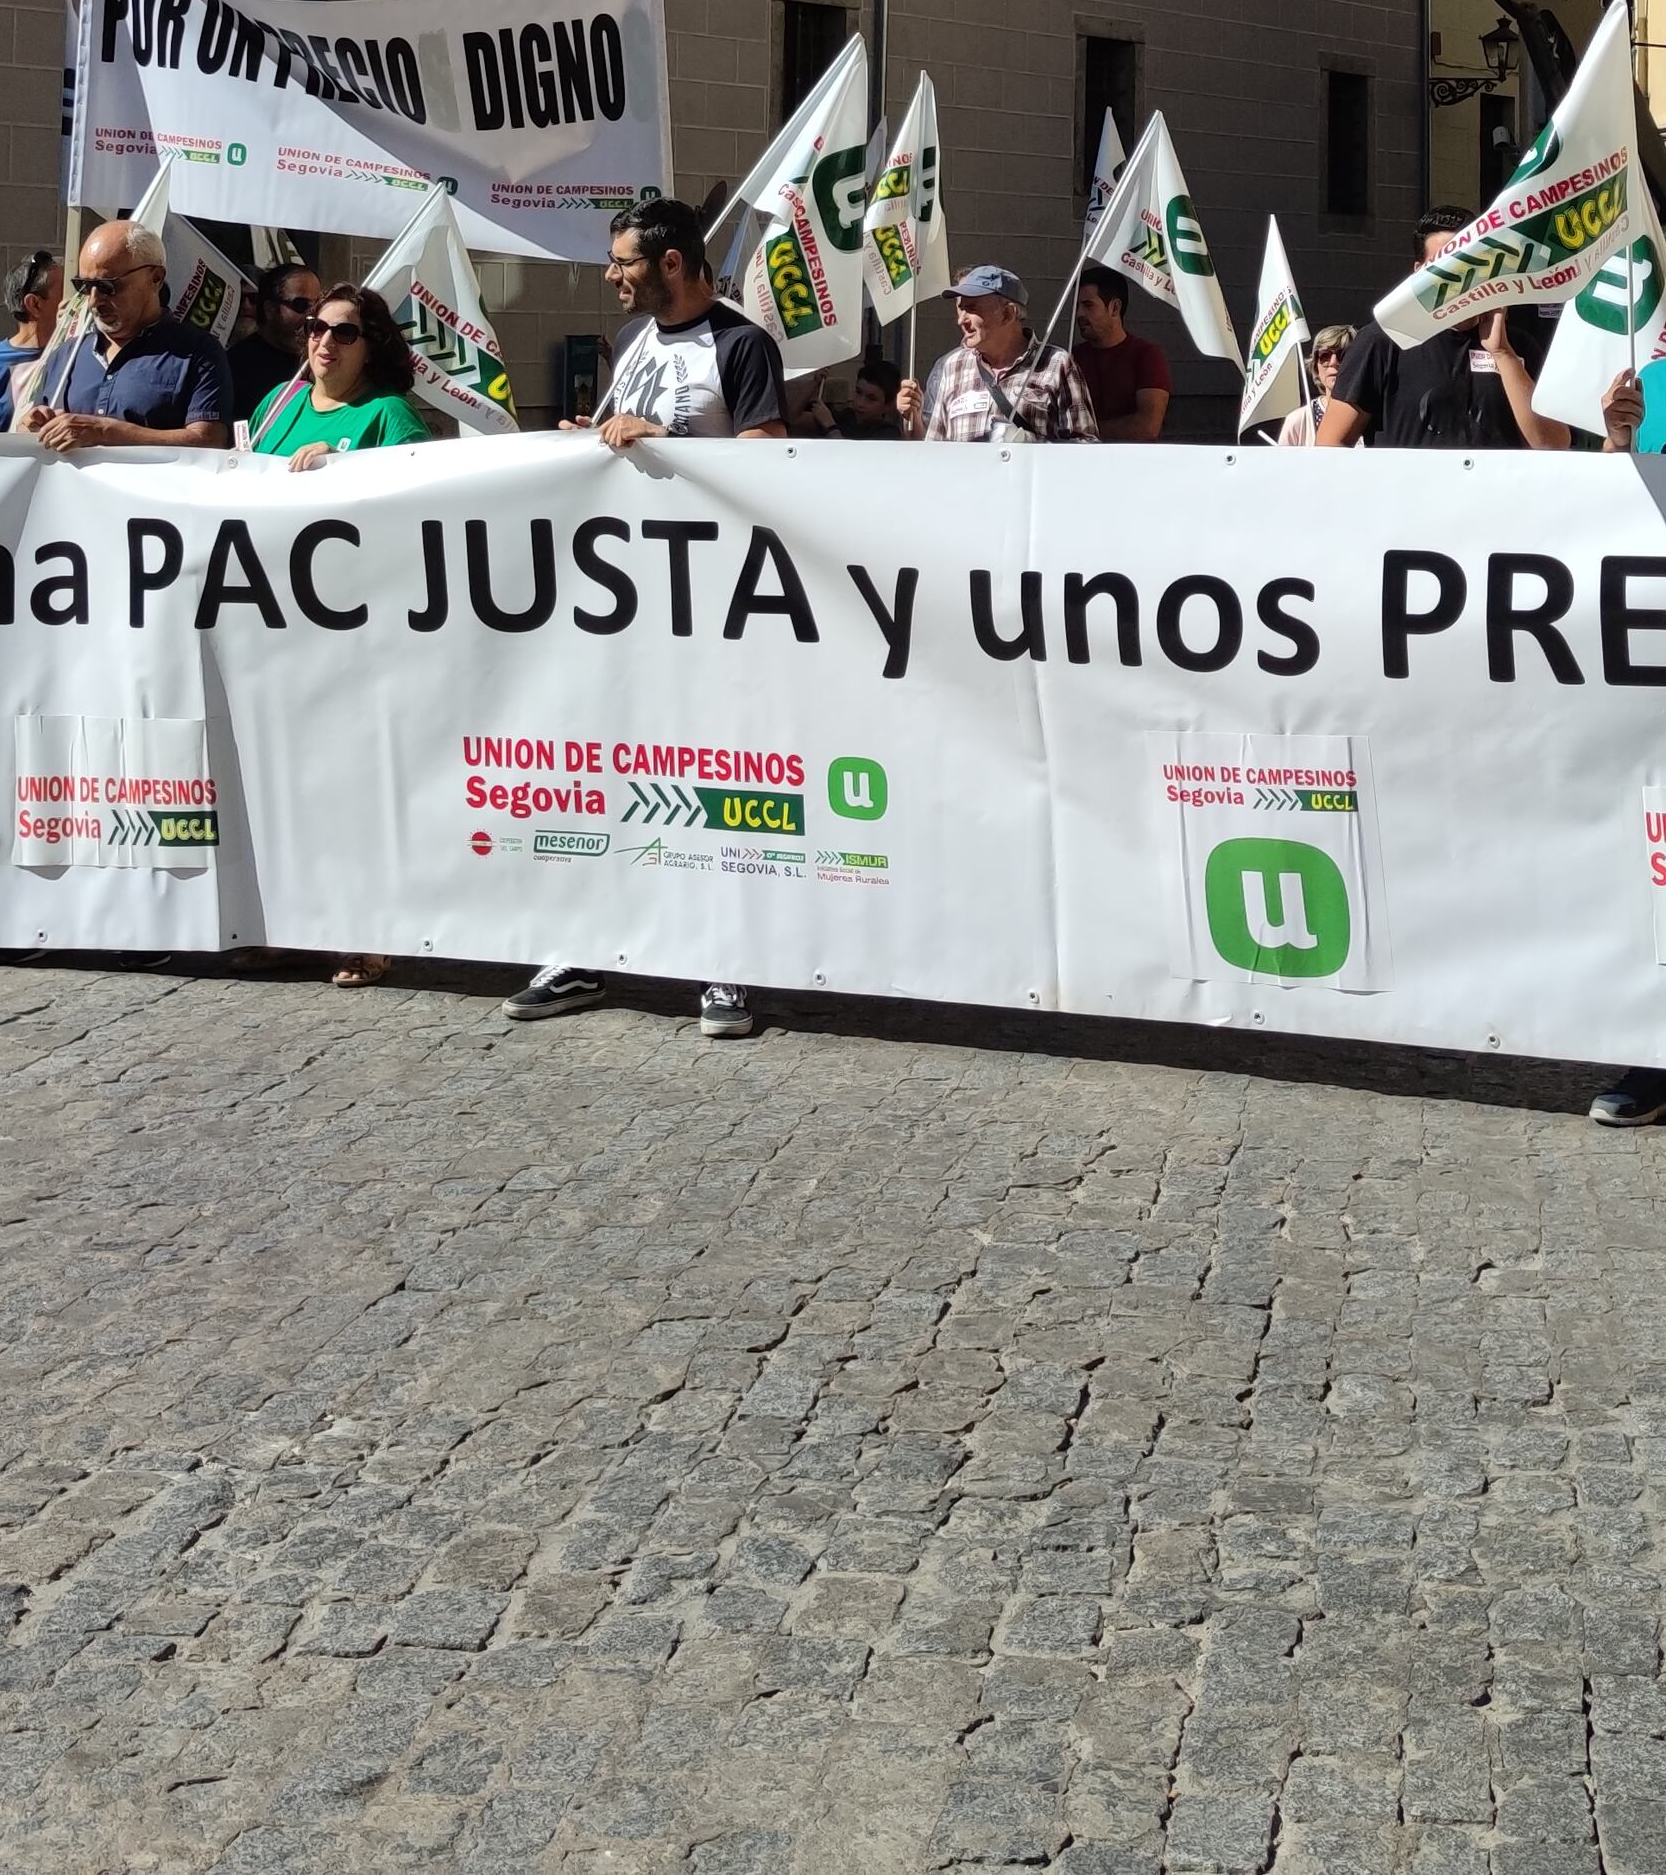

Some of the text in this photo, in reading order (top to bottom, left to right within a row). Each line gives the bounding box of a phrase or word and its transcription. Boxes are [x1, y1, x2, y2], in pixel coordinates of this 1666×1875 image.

[263, 21, 427, 126] PRECIO
[463, 14, 627, 132] DIGNO
[95, 127, 222, 150] UNION DE CAMPESINOS
[95, 139, 158, 156] Segovia
[277, 147, 431, 181] UNION DE CAMPESINOS
[277, 159, 343, 178] Segovia
[490, 194, 556, 209] Segovia
[492, 183, 634, 196] UNION DE CAMPESINOS
[1477, 146, 1629, 236] DE CAMPESINOS
[1121, 252, 1162, 286] Castilla y
[1433, 283, 1509, 320] Castilla
[1512, 278, 1525, 294] y
[1526, 265, 1578, 291] León
[410, 280, 487, 345] UNION DE
[430, 373, 440, 385] y
[441, 379, 478, 410] León
[127, 517, 368, 631] PAC
[408, 516, 820, 643] JUSTA
[847, 564, 920, 679] y
[969, 569, 1321, 677] unos
[463, 736, 805, 787] UNION DE CAMPESINOS
[1163, 765, 1358, 788] UNION DE CAMPESINOS
[17, 776, 218, 805] UNION DE CAMPESINOS
[465, 775, 797, 831] Segovia UCCL
[842, 771, 874, 809] u
[1167, 785, 1354, 810] Segovia UCCL
[18, 810, 216, 844] Segovia UCCL
[535, 834, 605, 851] mesenor
[663, 851, 714, 863] GRUPO ASESOR
[721, 846, 741, 859] UNI
[846, 854, 887, 867] ISMUR
[721, 861, 781, 877] SEGOVIA,
[1240, 870, 1318, 950] u
